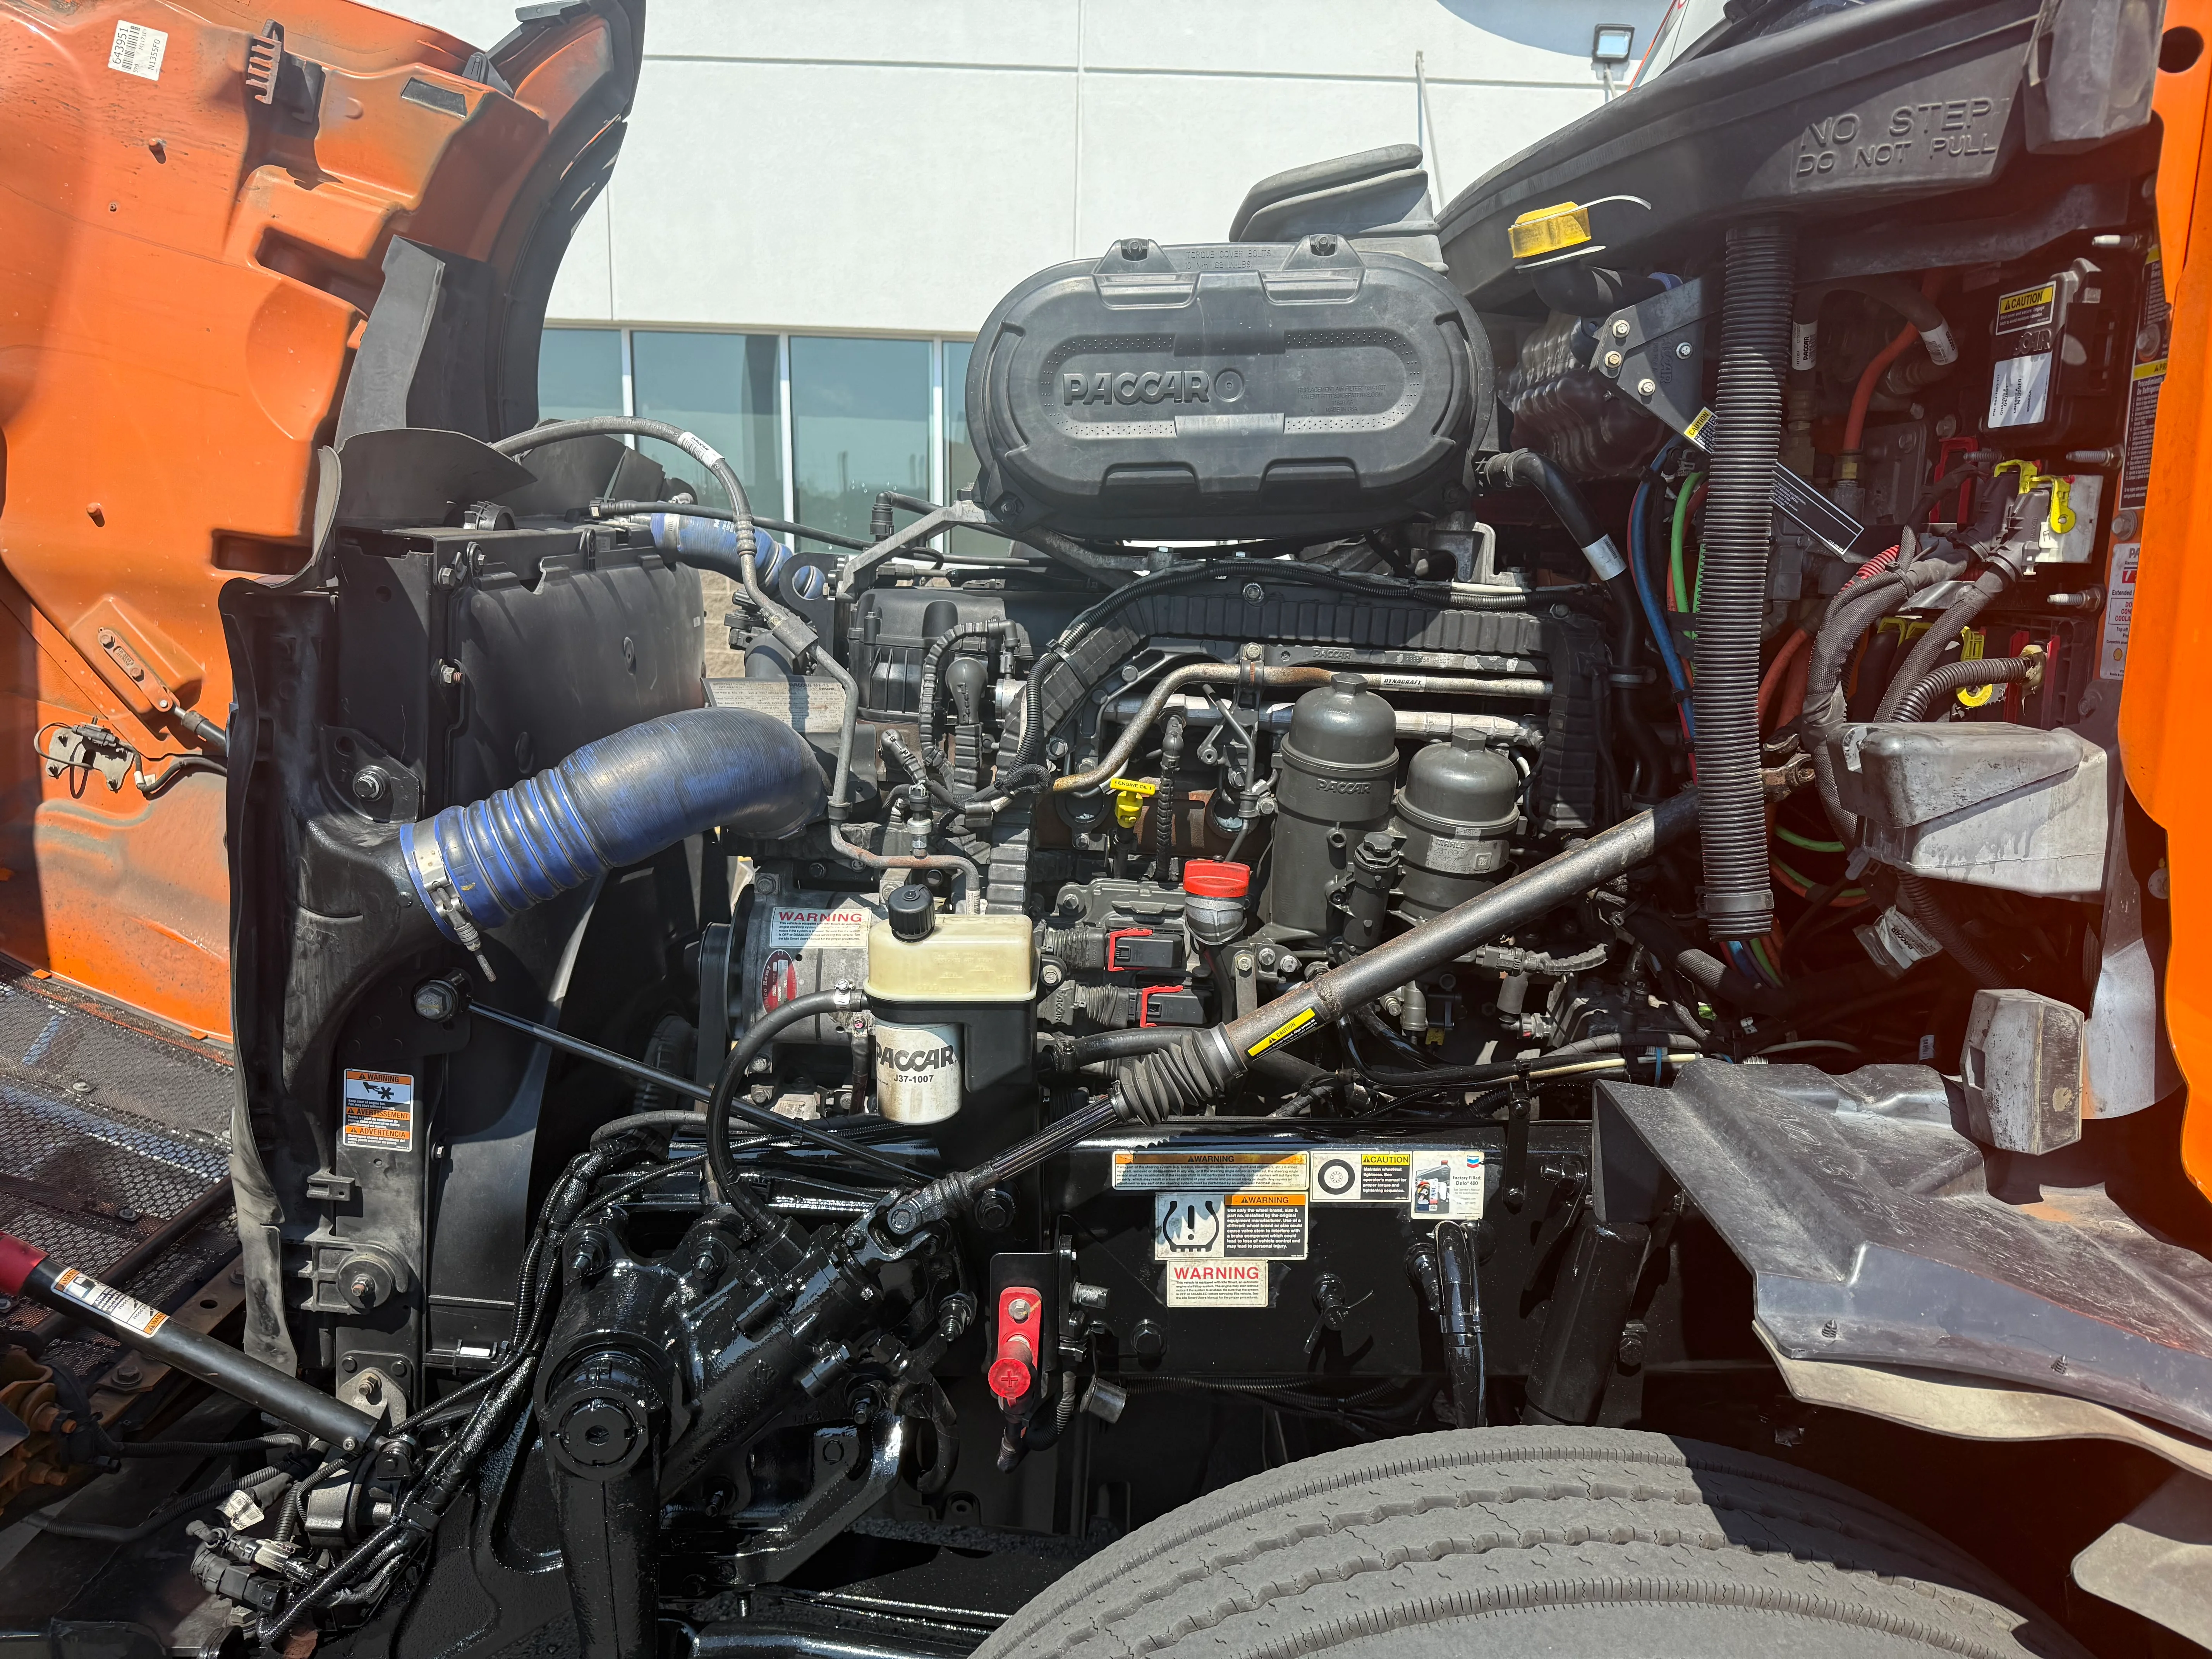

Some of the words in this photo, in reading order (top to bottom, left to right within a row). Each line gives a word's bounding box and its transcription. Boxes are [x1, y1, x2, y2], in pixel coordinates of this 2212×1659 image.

[112, 28, 128, 64] 643951
[1801, 113, 1859, 151] NO
[1889, 97, 1994, 136] STEP
[1796, 151, 1834, 175] DO
[1855, 141, 1911, 168] NOT
[1930, 134, 1997, 159] PULL
[2011, 291, 2043, 309] CAUTION
[1063, 371, 1210, 406] PACCAR
[1689, 412, 1709, 435] CAUTION
[1313, 649, 1352, 659] PACCAR
[1316, 778, 1372, 795] PACCAR
[1436, 837, 1466, 849] MAHLE
[779, 912, 862, 922] WARNING
[1891, 928, 1914, 950] PACCAR
[763, 965, 771, 986] Remy
[1276, 1022, 1296, 1037] CAUTION
[877, 1041, 954, 1072] PACCAR
[368, 1073, 399, 1082] WARNING
[894, 1074, 934, 1083] J37-1007
[357, 1108, 409, 1119] AVERTISSEMENT
[360, 1128, 405, 1137] ADVERTENCIA
[1174, 1267, 1259, 1279] WARNING
[95, 1294, 105, 1305] After
[98, 1294, 112, 1309] ensure
[118, 1299, 128, 1309] Hood
[132, 1308, 143, 1319] Hood
